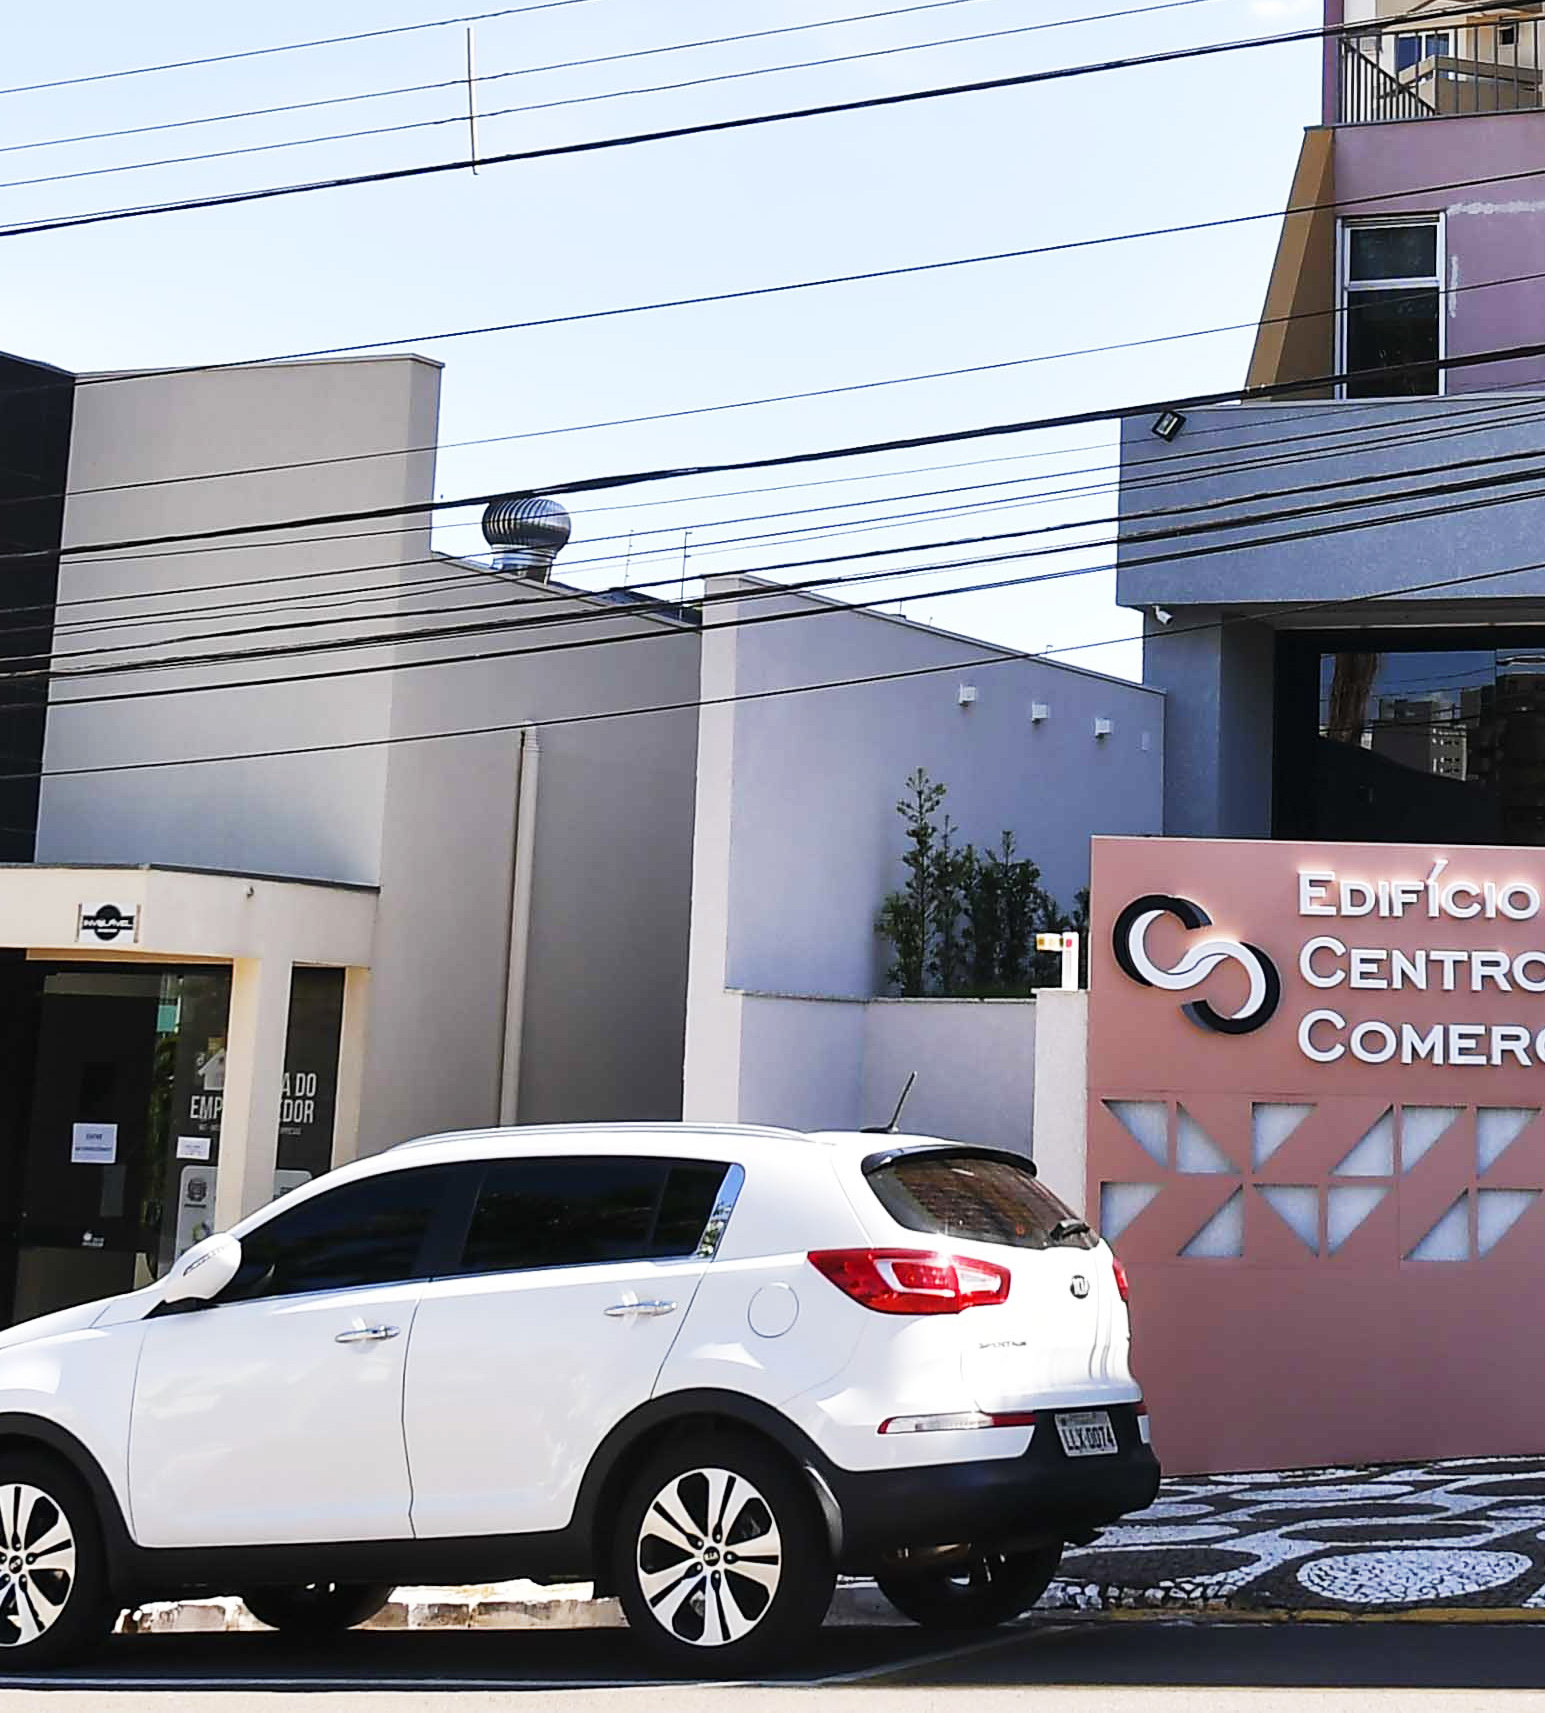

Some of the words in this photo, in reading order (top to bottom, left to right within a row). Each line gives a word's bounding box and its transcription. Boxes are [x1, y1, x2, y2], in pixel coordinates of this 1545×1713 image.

[1297, 858, 1541, 920] EDIFÍCIO
[1297, 1008, 1545, 1067] COMER
[294, 1072, 317, 1098] DO
